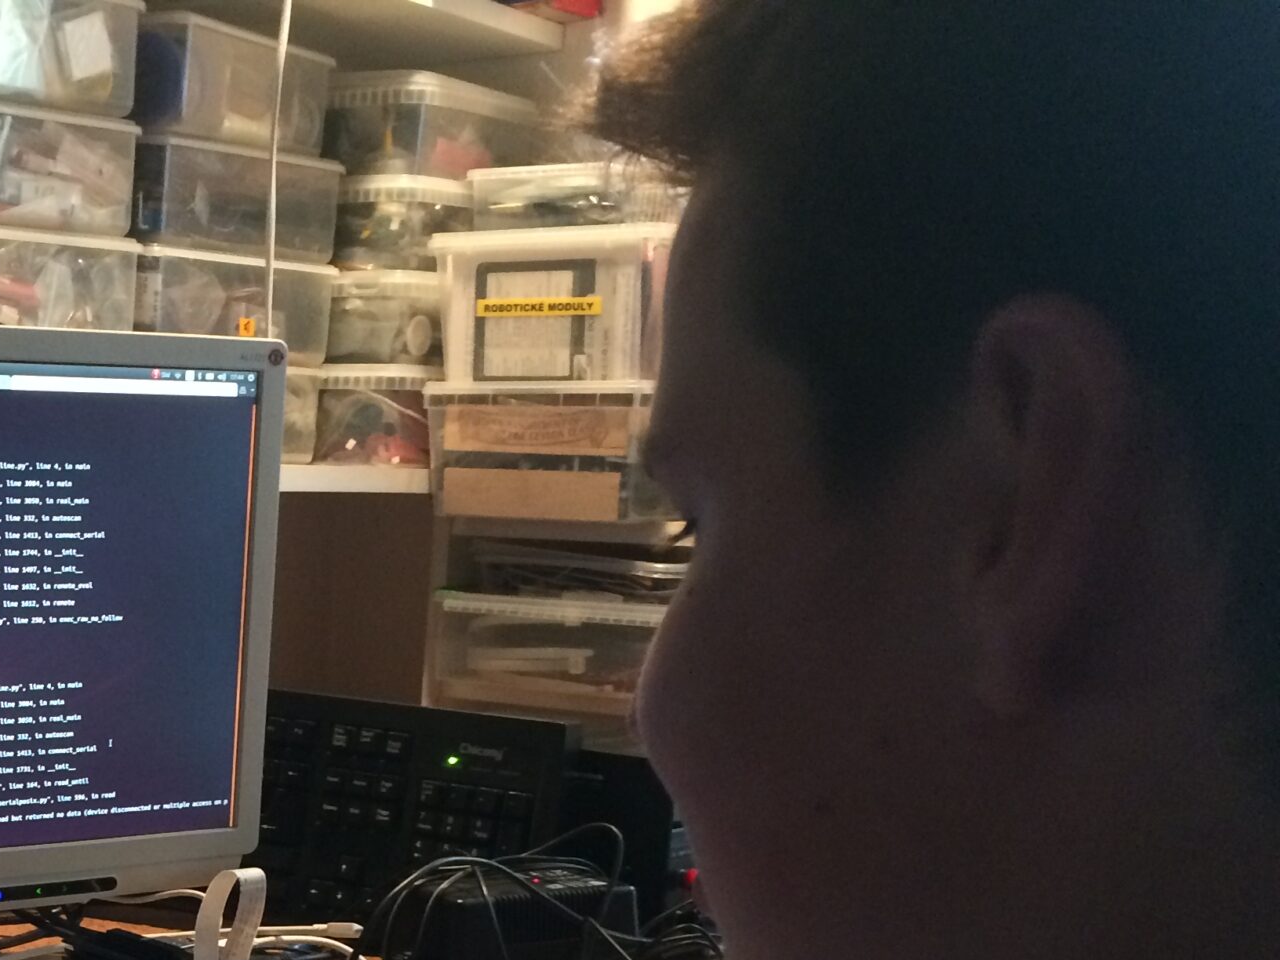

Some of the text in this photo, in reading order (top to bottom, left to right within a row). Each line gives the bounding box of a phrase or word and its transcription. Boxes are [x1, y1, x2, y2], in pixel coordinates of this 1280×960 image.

[484, 302, 594, 313] ROBOTICKÉ MODULY
[53, 462, 62, 471] 4,
[65, 462, 73, 470] in
[75, 462, 91, 470] main
[6, 479, 22, 487] line
[46, 479, 55, 487] in
[6, 496, 21, 504] line
[46, 496, 54, 504] in
[56, 497, 89, 506] real_main
[5, 514, 21, 522] line
[41, 514, 50, 522] in
[52, 514, 82, 522] autoscan
[5, 531, 20, 539] line
[44, 531, 53, 539] in
[55, 531, 105, 541] connect_serial
[11, 814, 23, 822] but
[25, 810, 54, 820] returned
[66, 809, 82, 817] data
[84, 807, 108, 818] (device
[111, 803, 151, 814] disconnected
[163, 800, 190, 811] multiple
